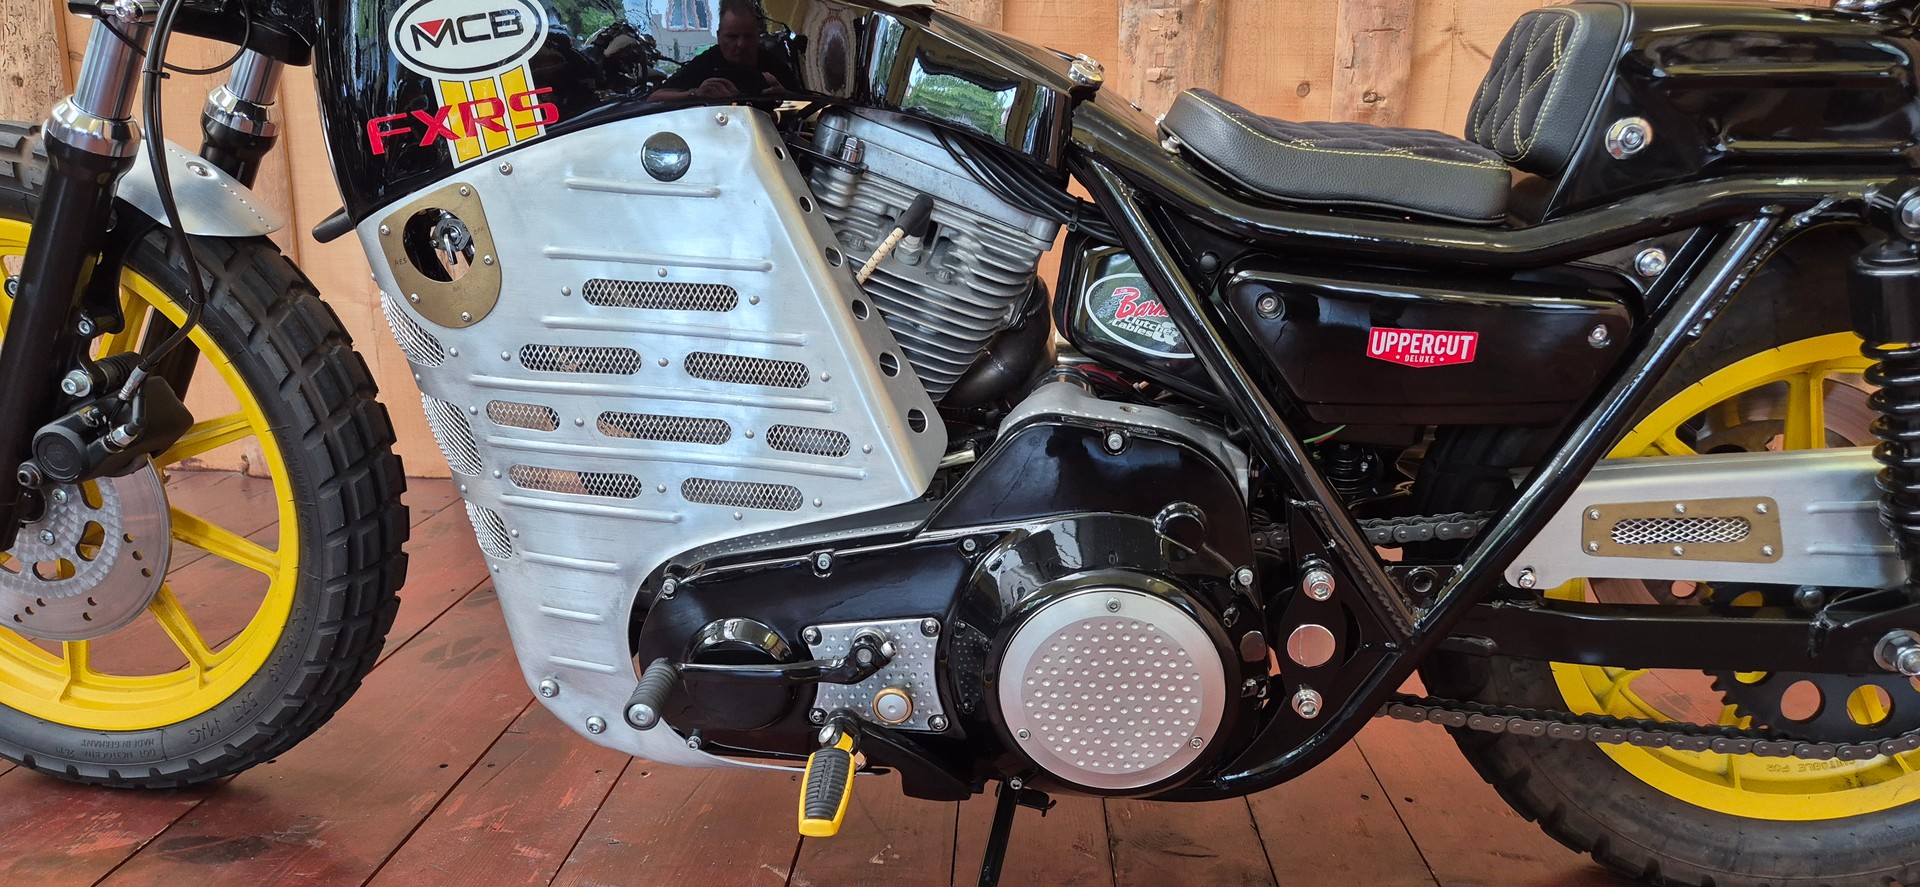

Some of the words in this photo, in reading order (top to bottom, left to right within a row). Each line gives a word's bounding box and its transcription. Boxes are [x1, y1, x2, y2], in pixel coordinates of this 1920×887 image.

[409, 8, 525, 52] MCB
[366, 86, 560, 155] FXRS
[1111, 286, 1170, 320] Barn
[1111, 319, 1153, 338] Cables
[1371, 331, 1474, 360] UPPERCUT
[1404, 354, 1436, 364] DELUXE
